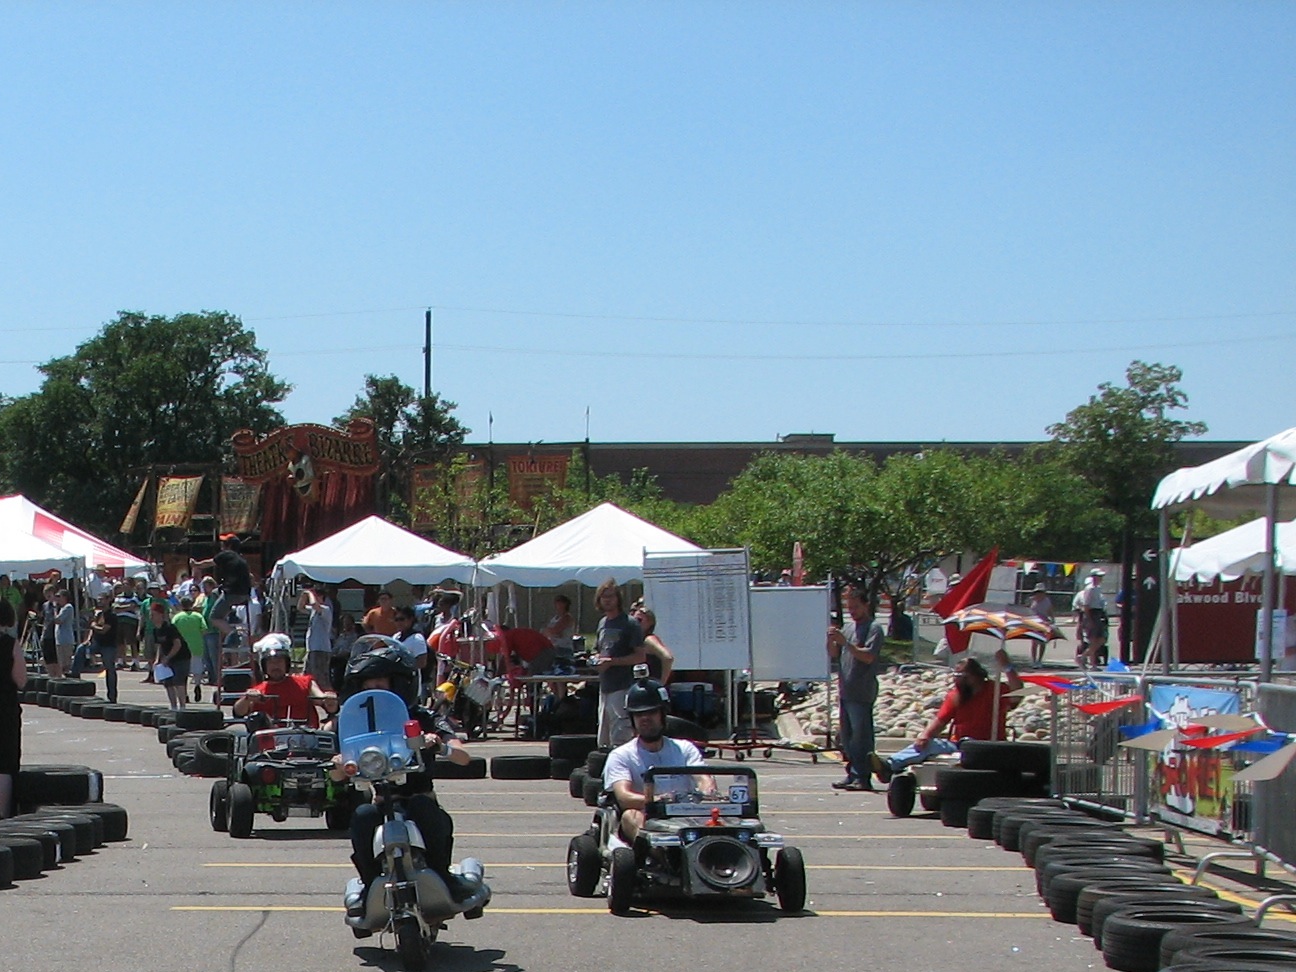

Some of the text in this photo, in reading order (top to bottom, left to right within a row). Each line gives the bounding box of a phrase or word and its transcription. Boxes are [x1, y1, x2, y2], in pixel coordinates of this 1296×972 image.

[1177, 592, 1229, 604] akwood
[359, 696, 376, 732] 1
[732, 789, 746, 800] 67
